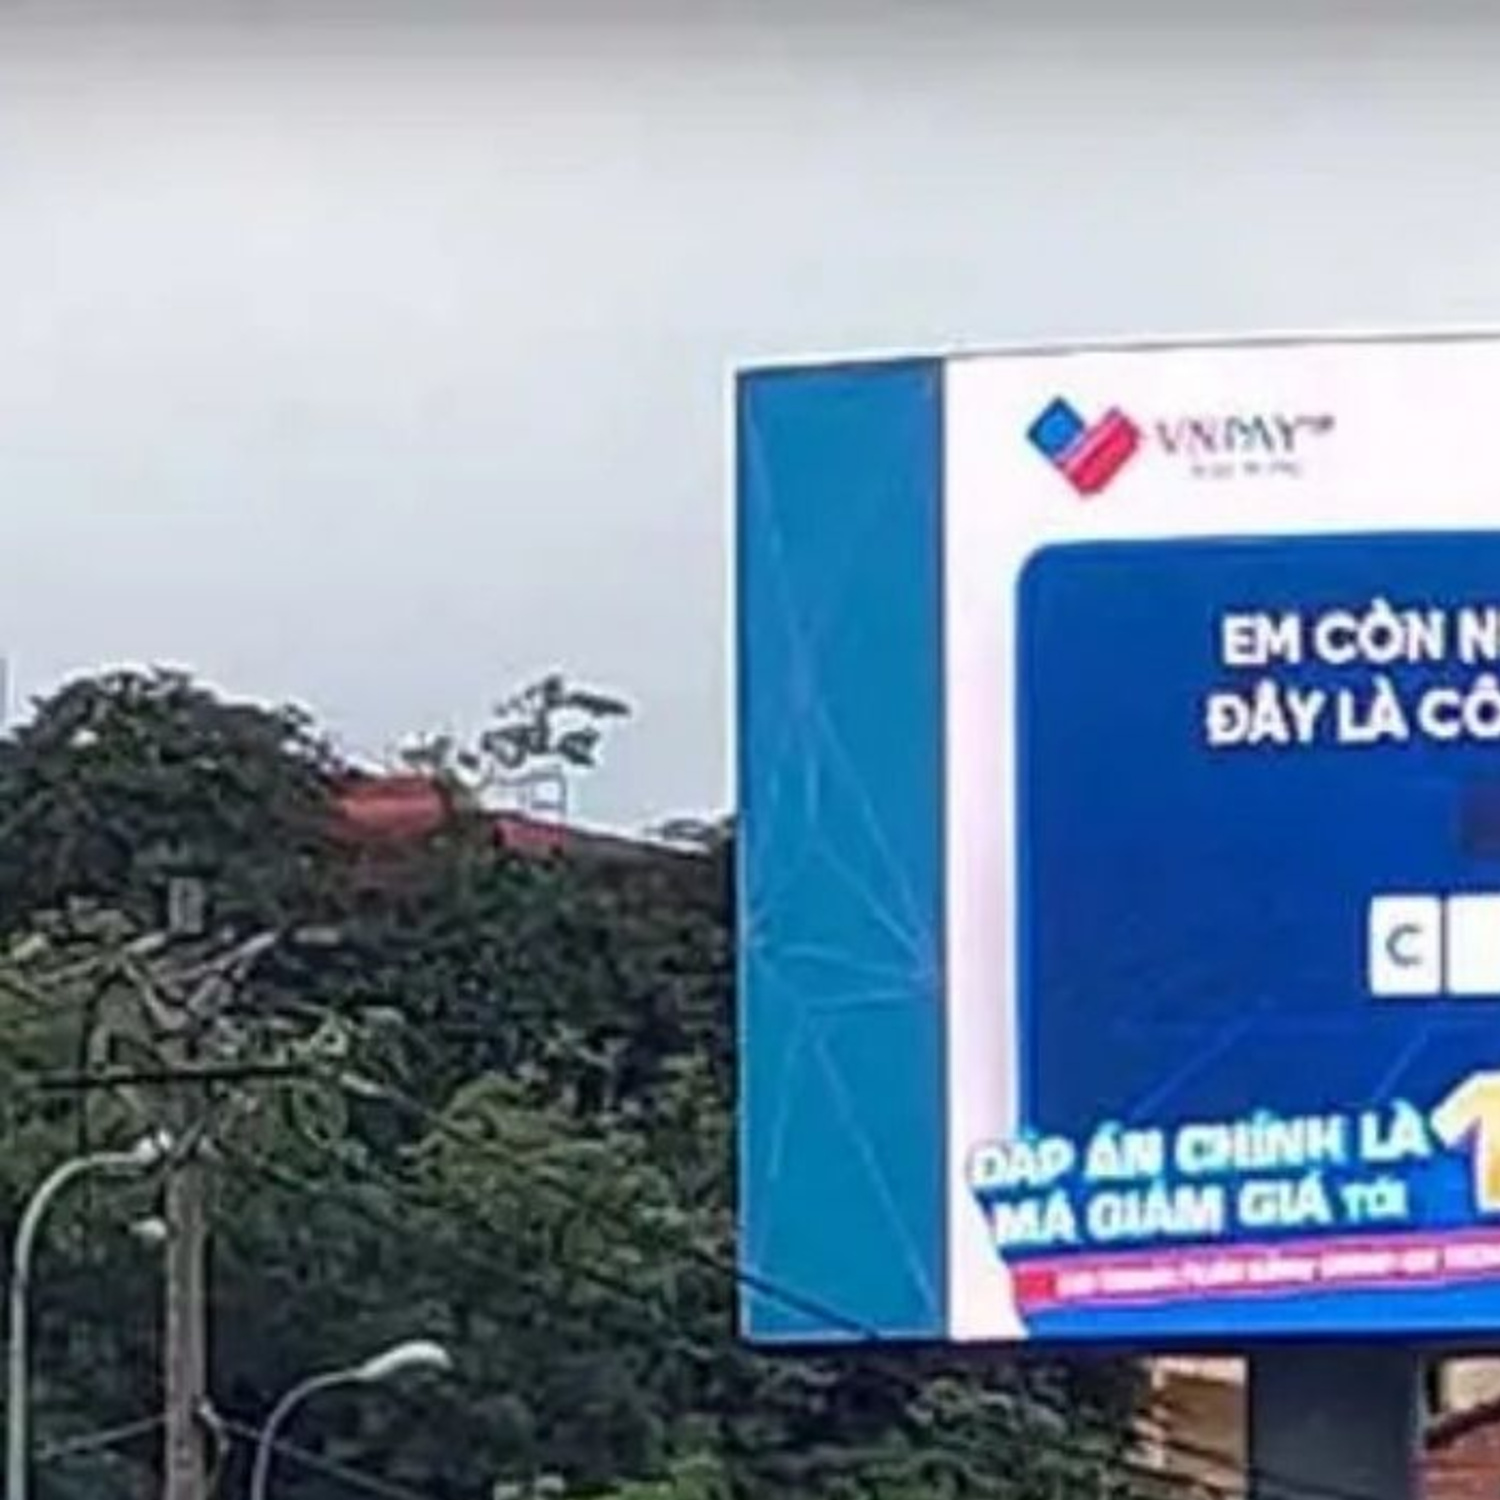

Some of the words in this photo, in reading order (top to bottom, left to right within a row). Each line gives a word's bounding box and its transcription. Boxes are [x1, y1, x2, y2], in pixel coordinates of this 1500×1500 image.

[1222, 612, 1300, 665] EM
[1315, 597, 1445, 662] CÒN
[1206, 676, 1325, 745] ĐÂY
[1336, 675, 1411, 744] LÀ
[1384, 924, 1424, 967] C
[1360, 1098, 1431, 1161] LÀ
[1238, 1169, 1334, 1227] GIÁ
